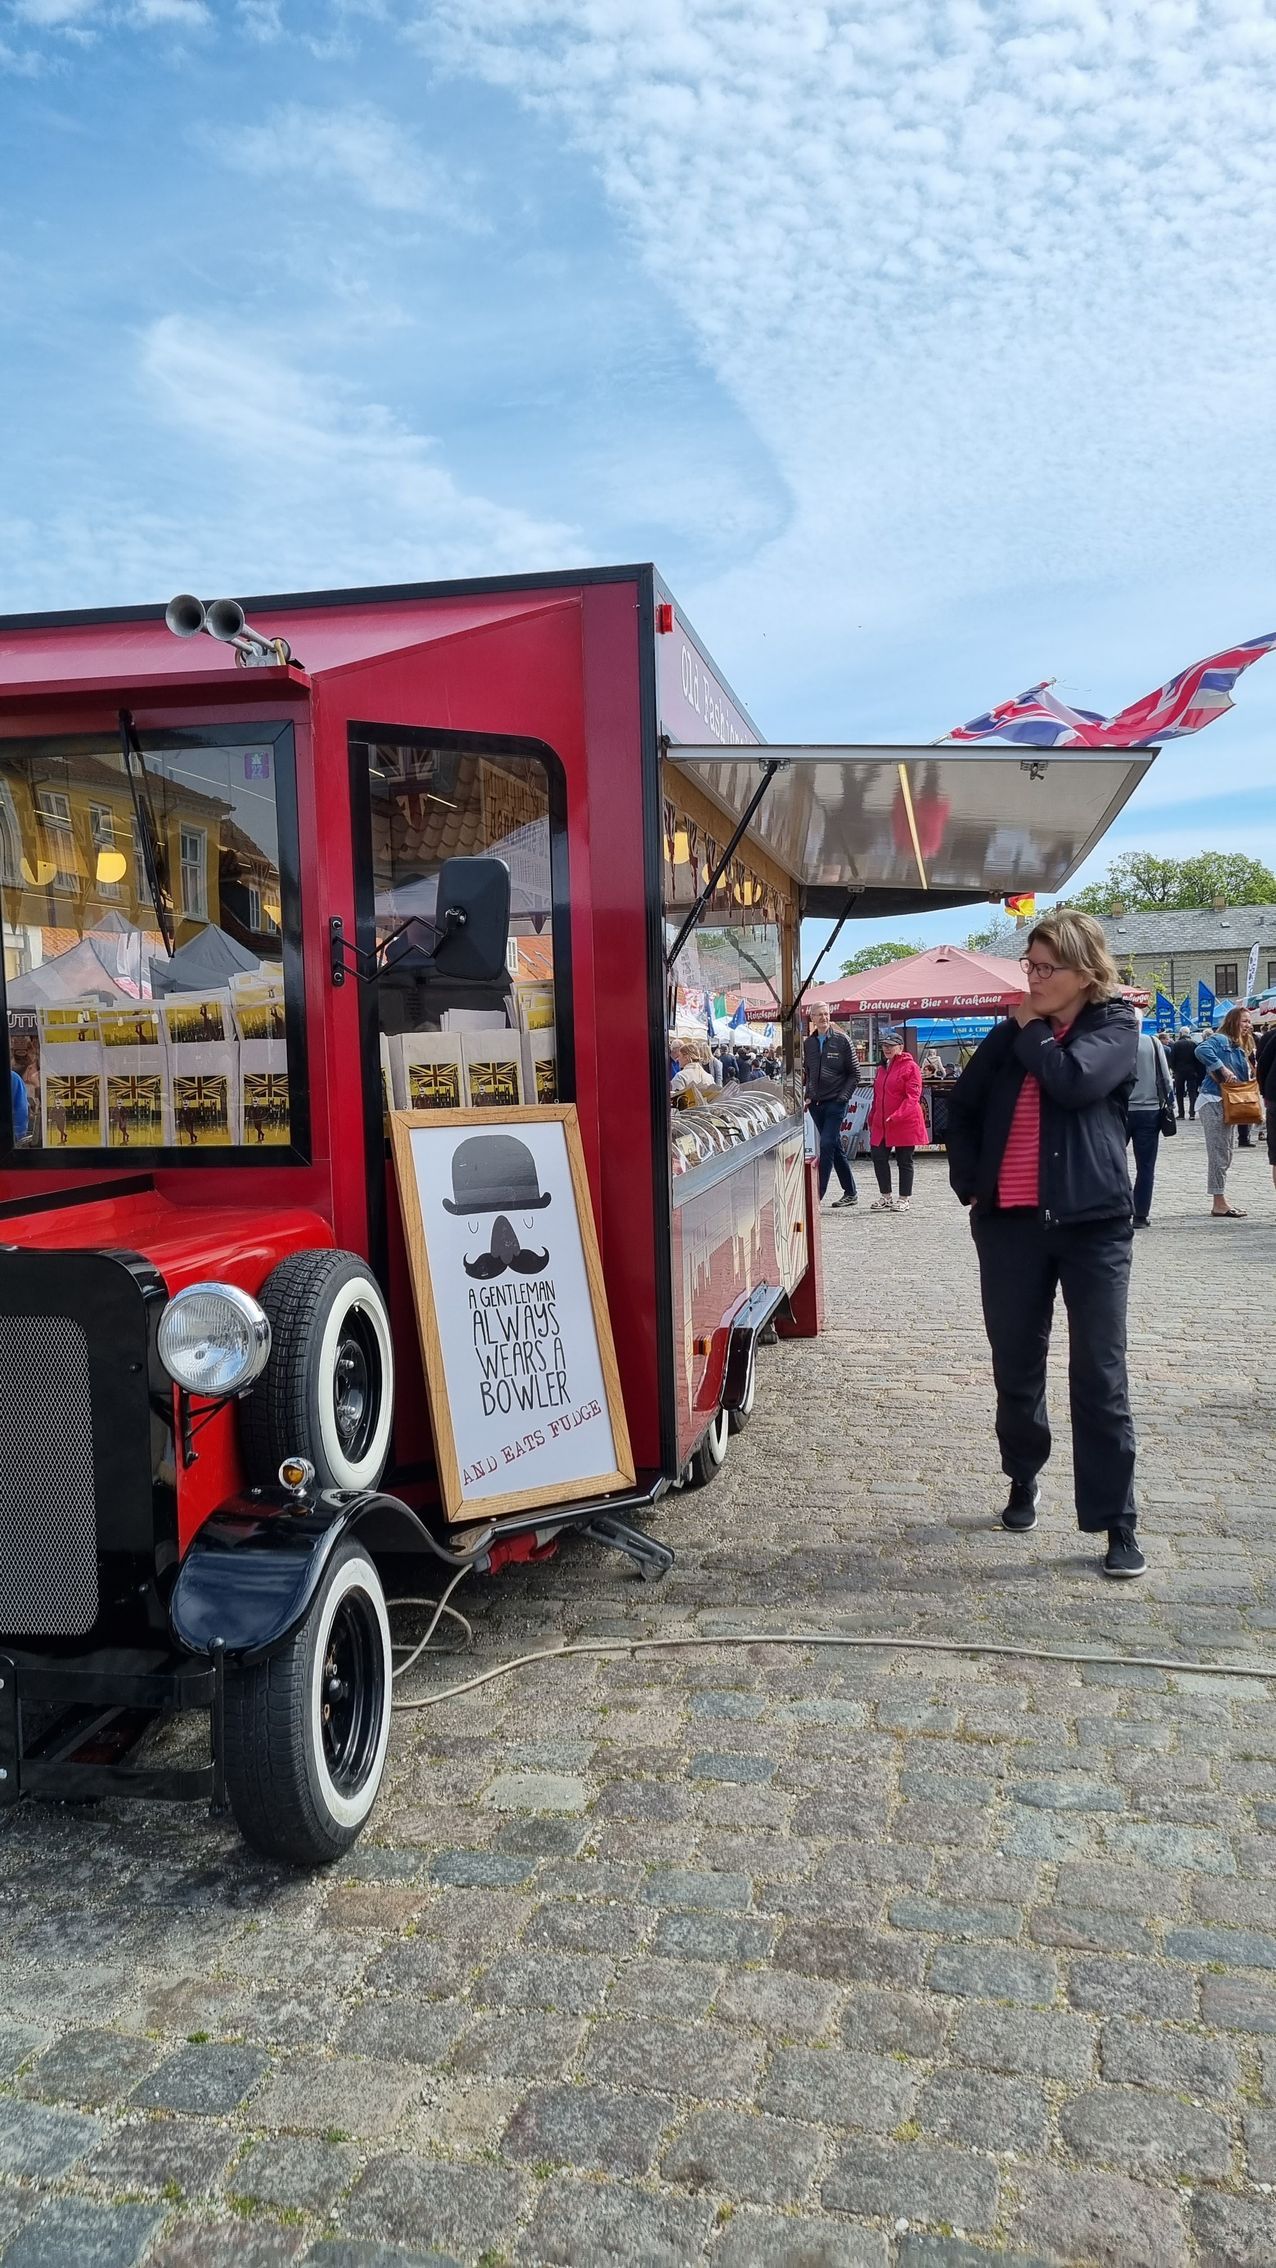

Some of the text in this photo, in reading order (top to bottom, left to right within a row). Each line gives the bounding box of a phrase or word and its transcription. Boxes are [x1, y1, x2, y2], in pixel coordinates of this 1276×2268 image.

[681, 645, 701, 714] Old
[859, 994, 1002, 1011] Bratwurst Bier Krakauer
[469, 1280, 556, 1309] A GENTLEMAN
[473, 1302, 560, 1346] ALWAYS
[475, 1337, 566, 1380] WEARS A
[480, 1370, 571, 1416] BOWLER
[463, 1399, 602, 1486] AND EATS FUDGE
